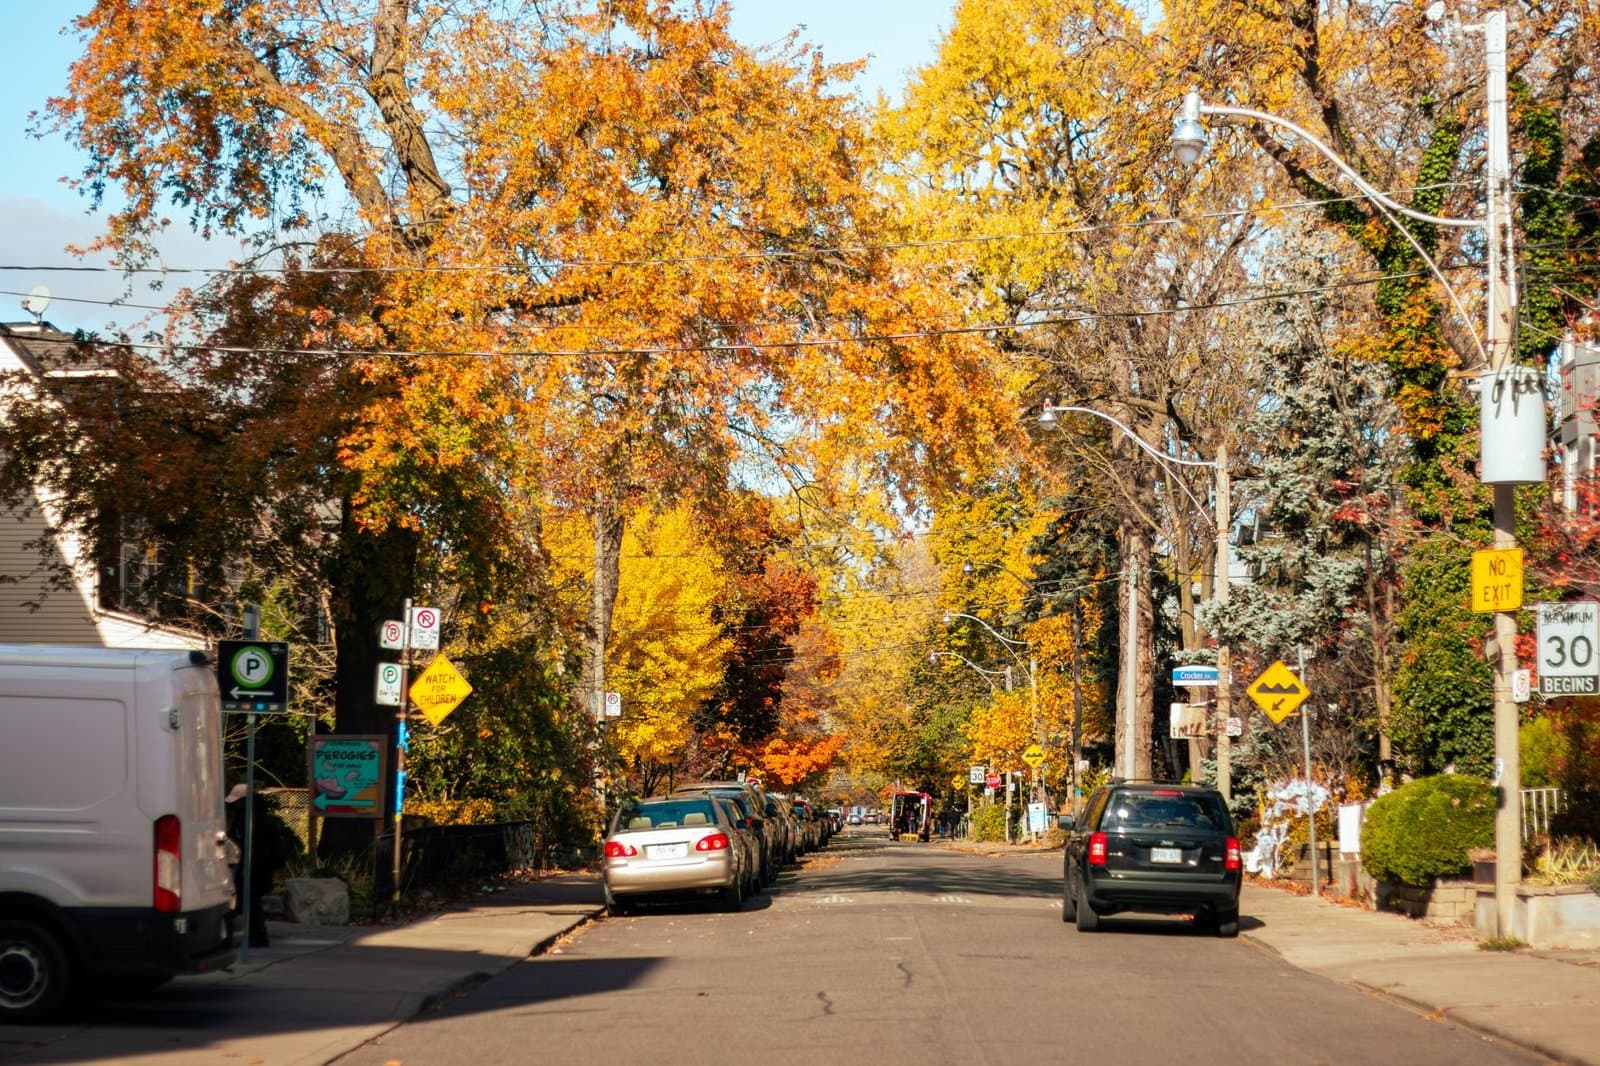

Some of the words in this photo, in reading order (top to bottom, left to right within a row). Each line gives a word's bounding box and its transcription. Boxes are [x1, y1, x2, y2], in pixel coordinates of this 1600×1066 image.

[1489, 559, 1506, 576] NO
[1483, 583, 1512, 602] EXIT
[1544, 611, 1593, 625] MAXIMUM
[1544, 635, 1593, 668] 30
[246, 658, 260, 676] P
[425, 674, 456, 684] WATCH
[1180, 671, 1203, 680] Crocker
[431, 685, 447, 693] FOR
[1544, 677, 1595, 693] BEGINS
[419, 694, 457, 705] CHILDREN
[315, 750, 377, 761] PEROGIES
[972, 772, 983, 781] 30
